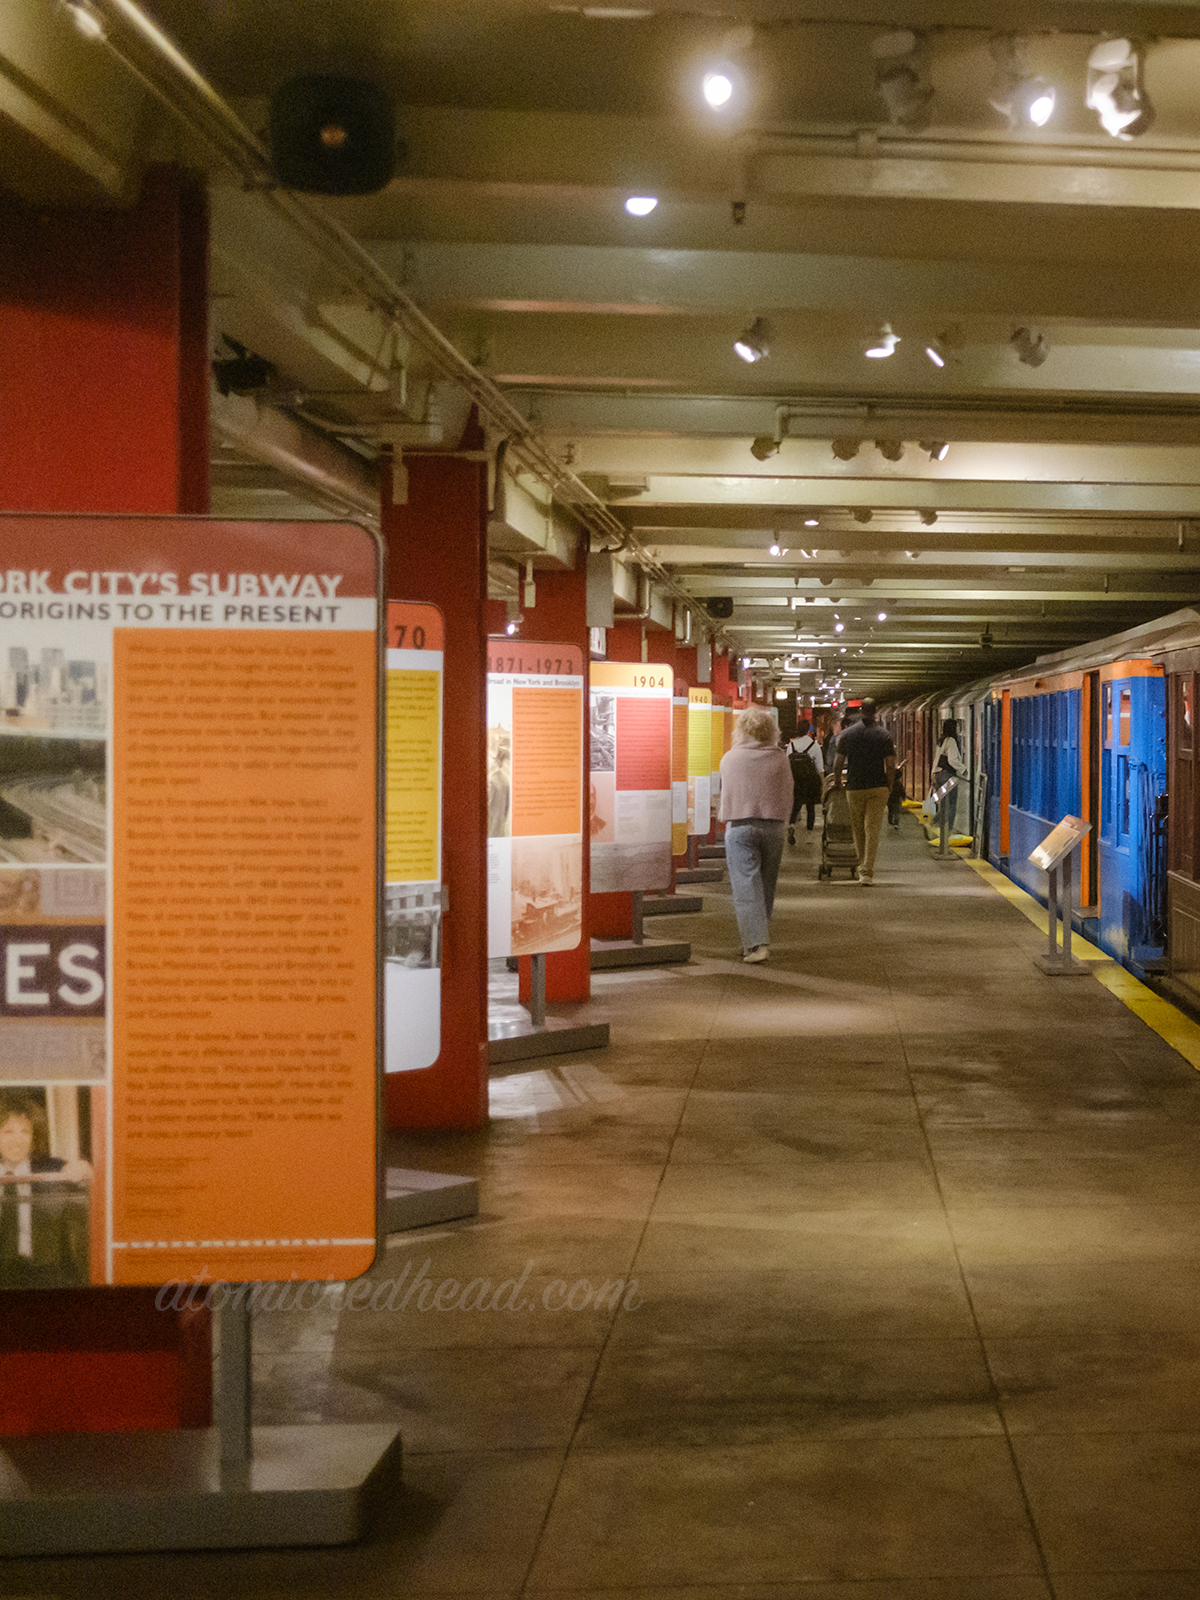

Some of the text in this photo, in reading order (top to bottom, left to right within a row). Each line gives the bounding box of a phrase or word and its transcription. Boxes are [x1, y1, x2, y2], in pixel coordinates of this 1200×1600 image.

[0, 570, 343, 598] RK CITY'S SUBWAY
[0, 602, 341, 623] ORIGINS TO THE PRESENT
[634, 676, 665, 688] 1904
[691, 695, 708, 704] 1940
[6, 943, 104, 1006] ES
